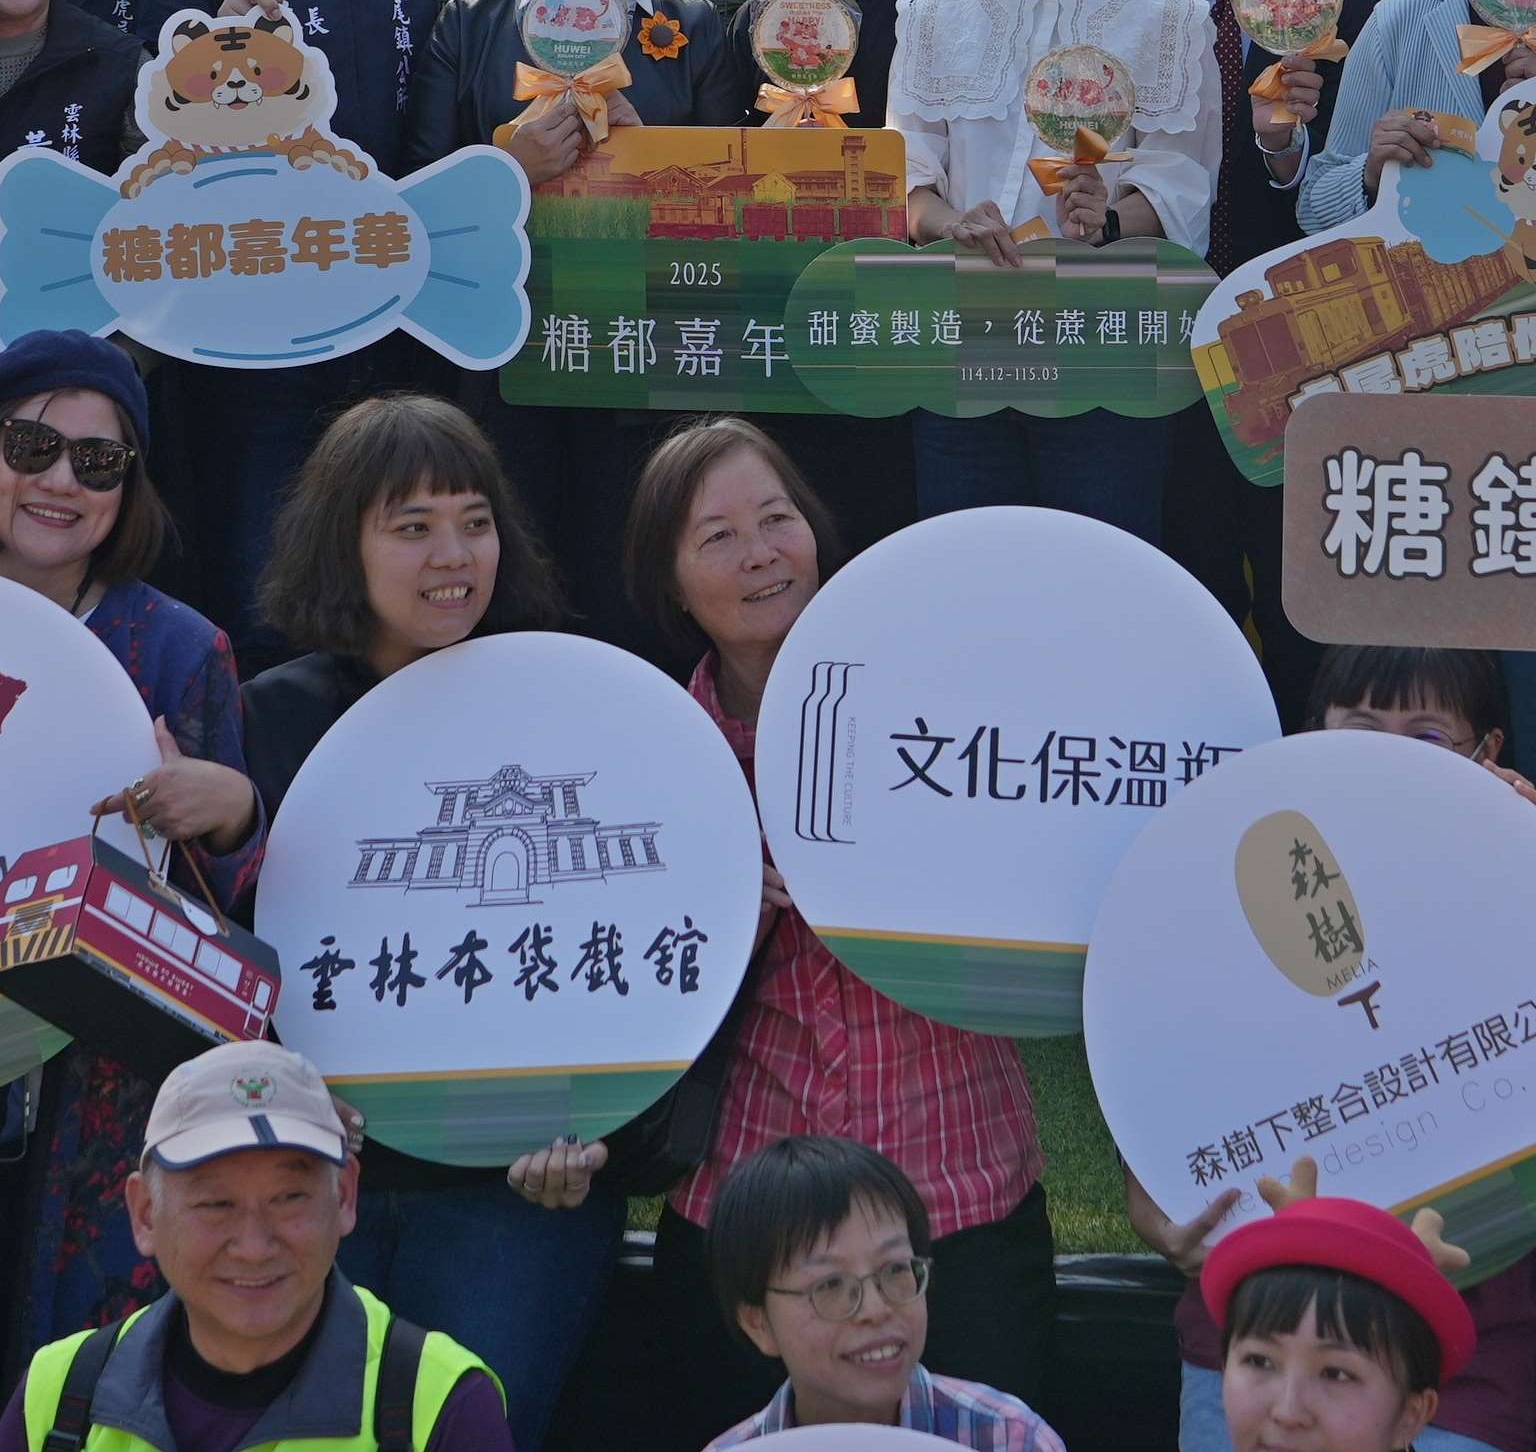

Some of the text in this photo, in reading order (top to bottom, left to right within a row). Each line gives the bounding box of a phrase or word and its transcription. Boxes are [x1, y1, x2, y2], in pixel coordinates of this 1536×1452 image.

[553, 44, 592, 55] HUWEI
[102, 211, 412, 283] 糖都嘉年華
[669, 262, 723, 286] 2025
[541, 313, 789, 378] 糖都嘉年
[960, 366, 1060, 382] 114.12-115.03
[842, 716, 857, 827] KEEPING THE CULTURE
[1287, 836, 1366, 964] 森樹
[1325, 957, 1381, 991] MELIA
[1323, 1109, 1440, 1177] design
[1460, 1080, 1529, 1113] Co.
